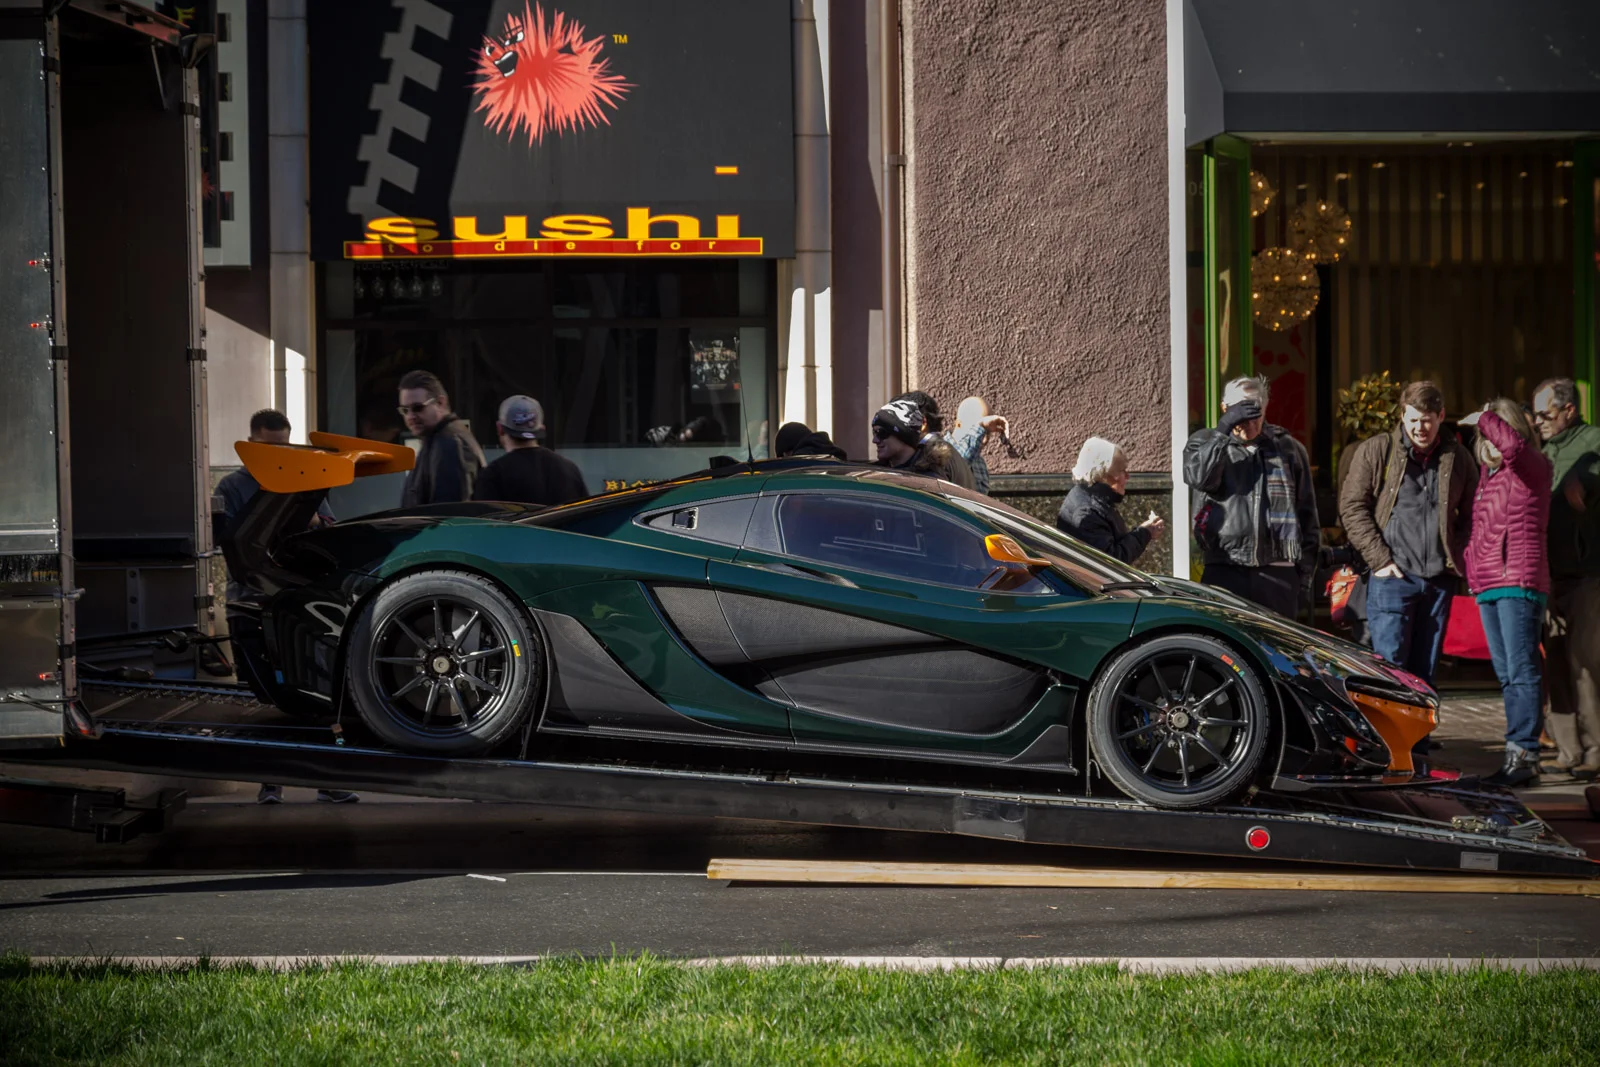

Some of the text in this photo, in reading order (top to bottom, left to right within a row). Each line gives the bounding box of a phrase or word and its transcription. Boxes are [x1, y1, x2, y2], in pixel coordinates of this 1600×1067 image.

[612, 33, 629, 45] TM
[387, 239, 717, 254] to die for
